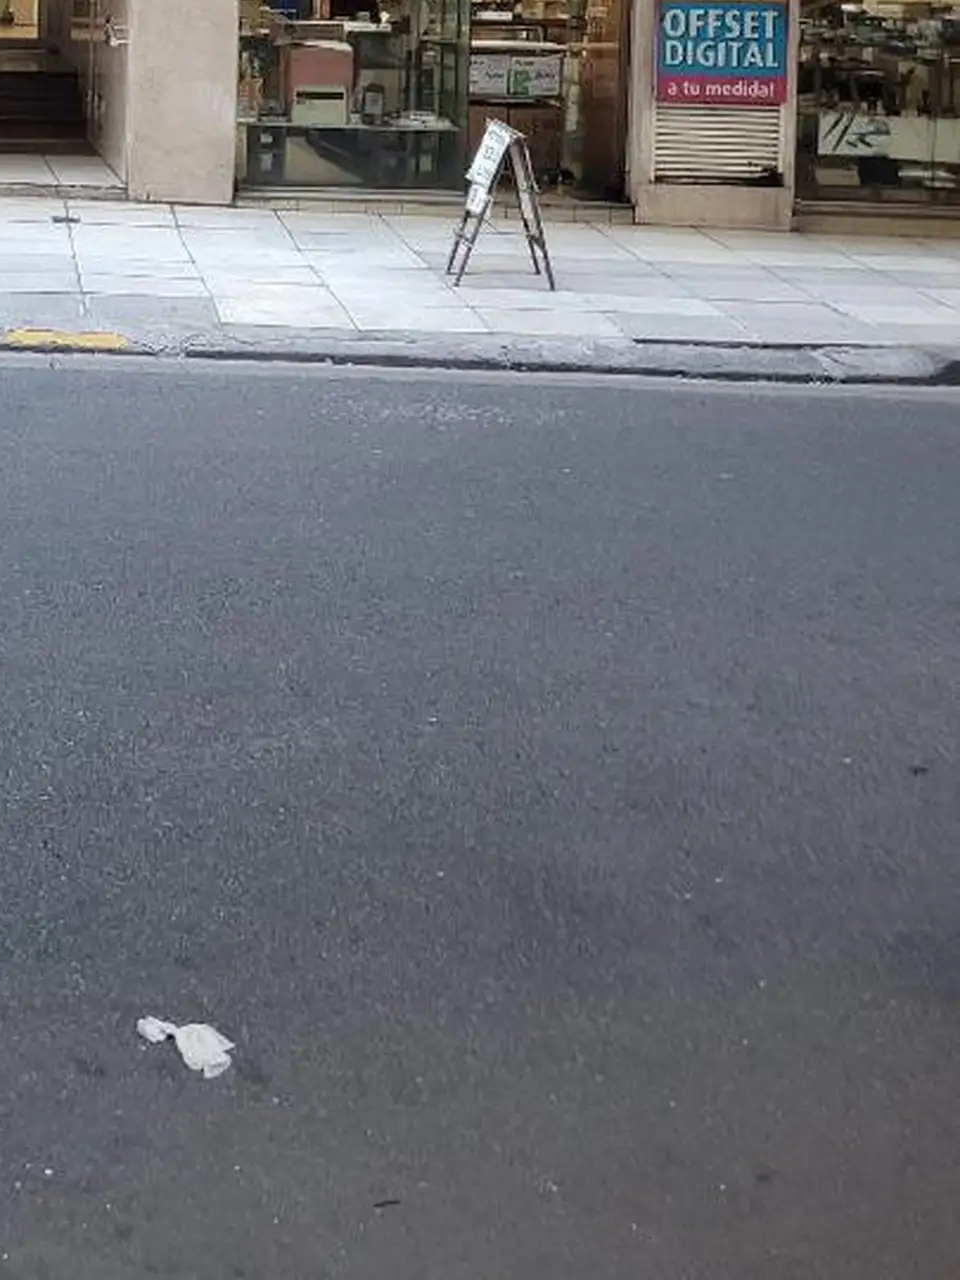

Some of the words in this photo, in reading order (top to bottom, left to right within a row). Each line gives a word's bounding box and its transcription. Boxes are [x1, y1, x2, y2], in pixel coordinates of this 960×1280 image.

[662, 8, 779, 39] OFFSET
[664, 40, 779, 68] DIGITAL
[667, 81, 678, 96] a
[683, 80, 700, 96] tu
